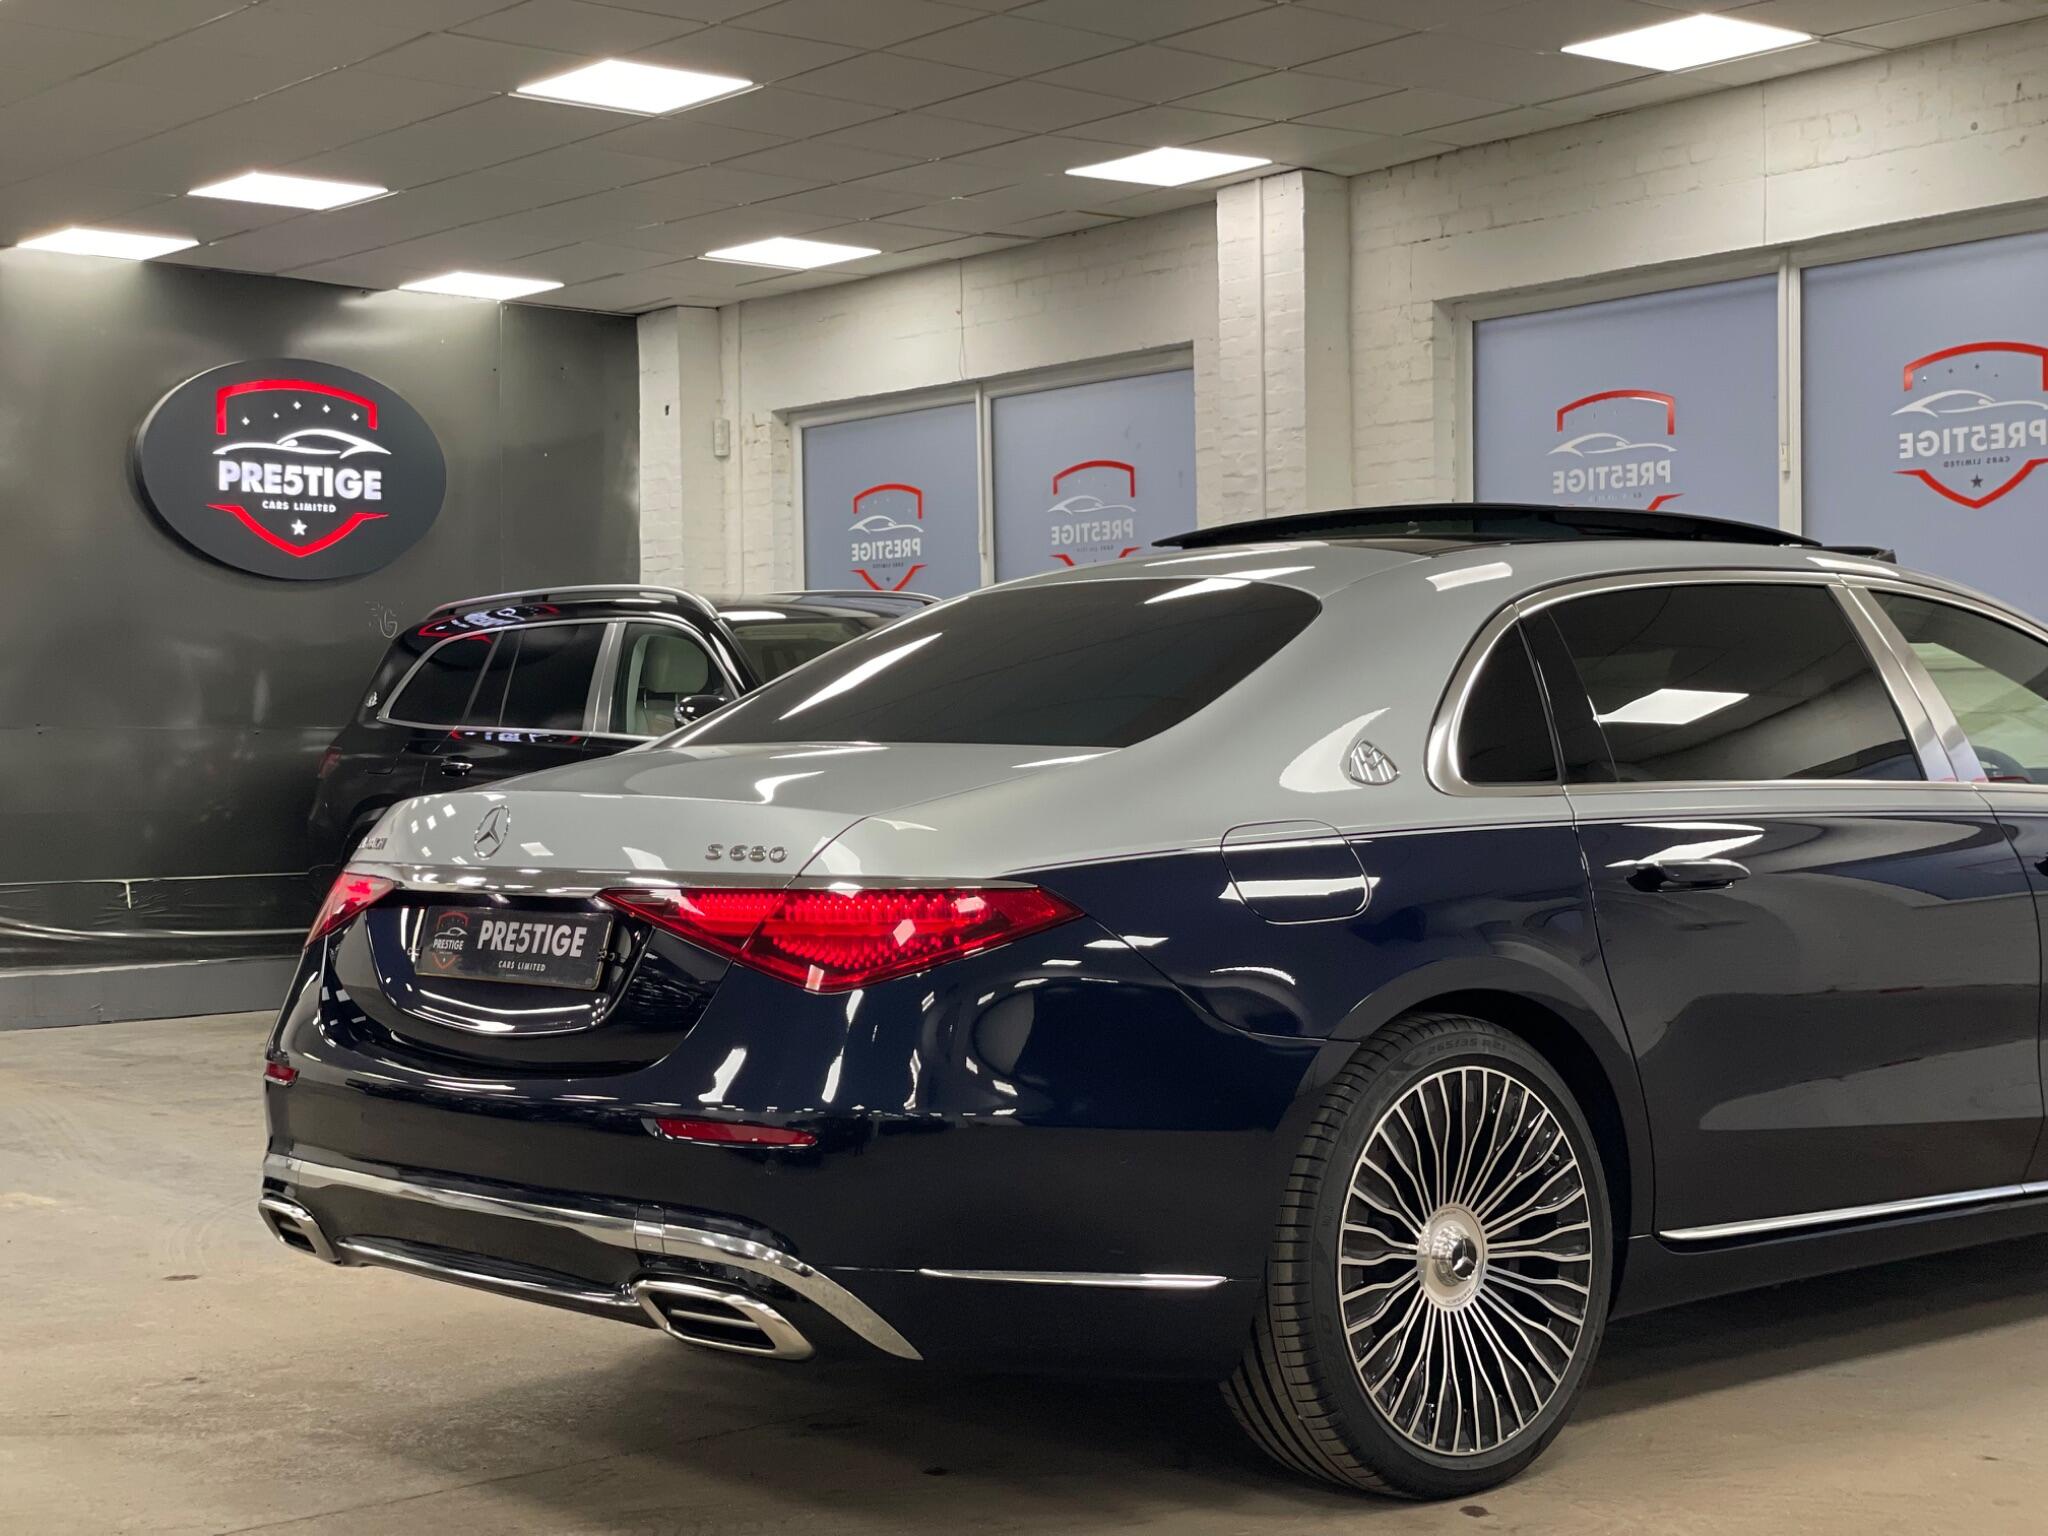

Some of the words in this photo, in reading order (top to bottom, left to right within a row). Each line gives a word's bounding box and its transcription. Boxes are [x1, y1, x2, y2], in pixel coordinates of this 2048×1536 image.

[262, 501, 290, 511] CARS
[293, 502, 337, 513] LIMITED
[705, 844, 724, 861] S
[729, 845, 788, 863] 680
[498, 960, 515, 970] CARS
[517, 962, 546, 972] LIMITED
